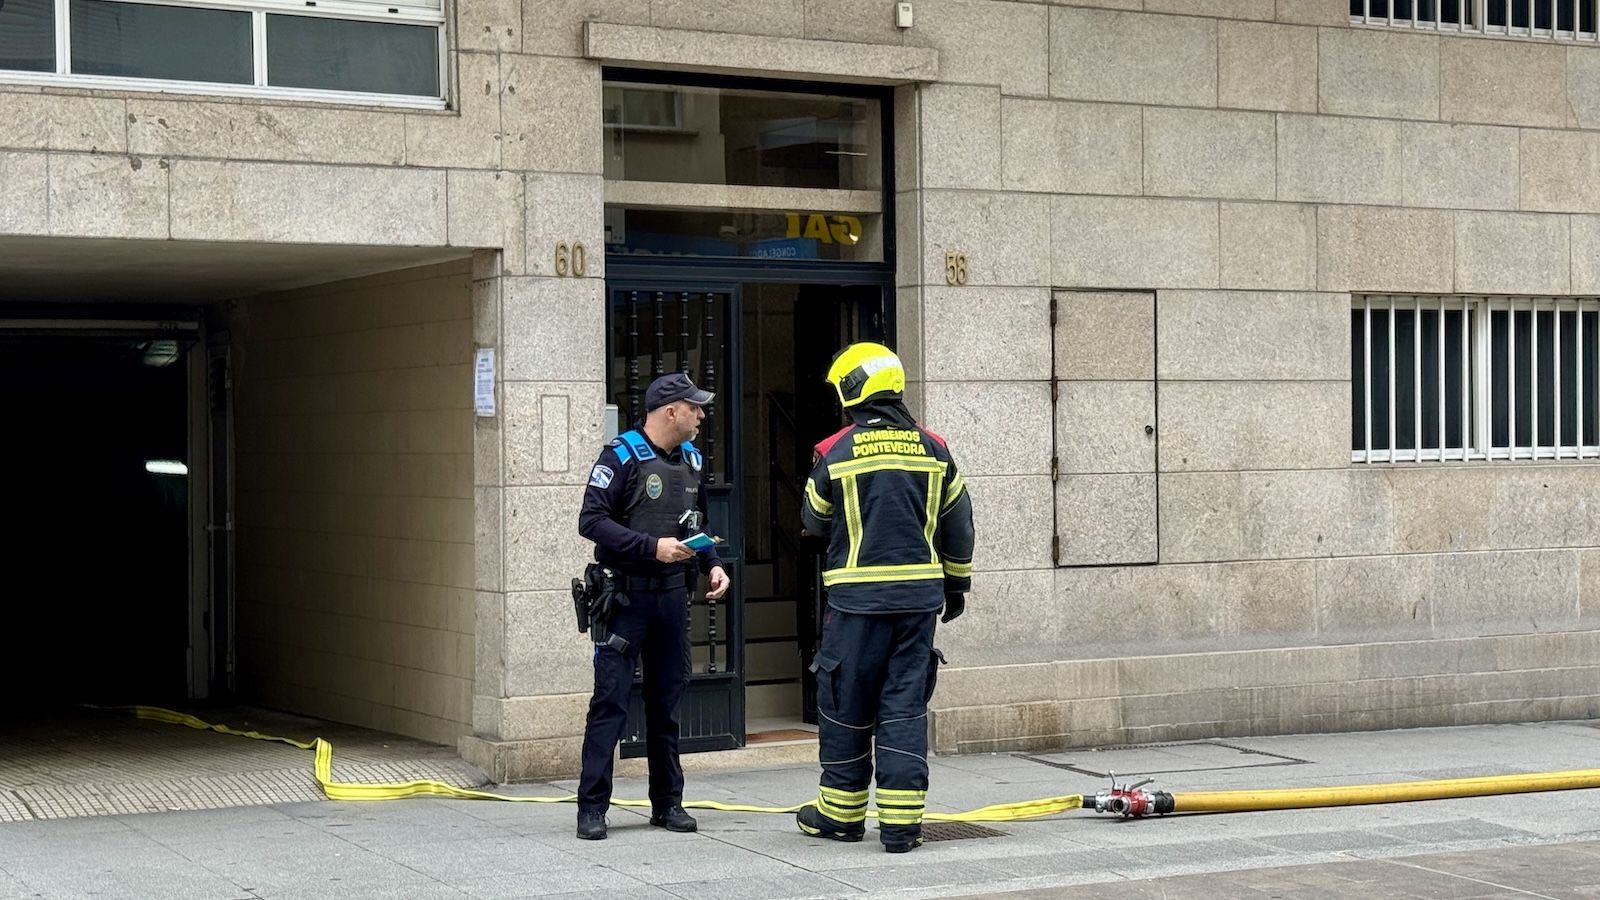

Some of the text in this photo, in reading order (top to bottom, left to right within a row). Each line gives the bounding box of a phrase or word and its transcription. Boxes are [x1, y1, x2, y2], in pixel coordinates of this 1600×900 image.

[555, 241, 585, 277] 60
[853, 430, 920, 444] BOMBEIROS
[852, 441, 927, 457] PONTEVEDRA
